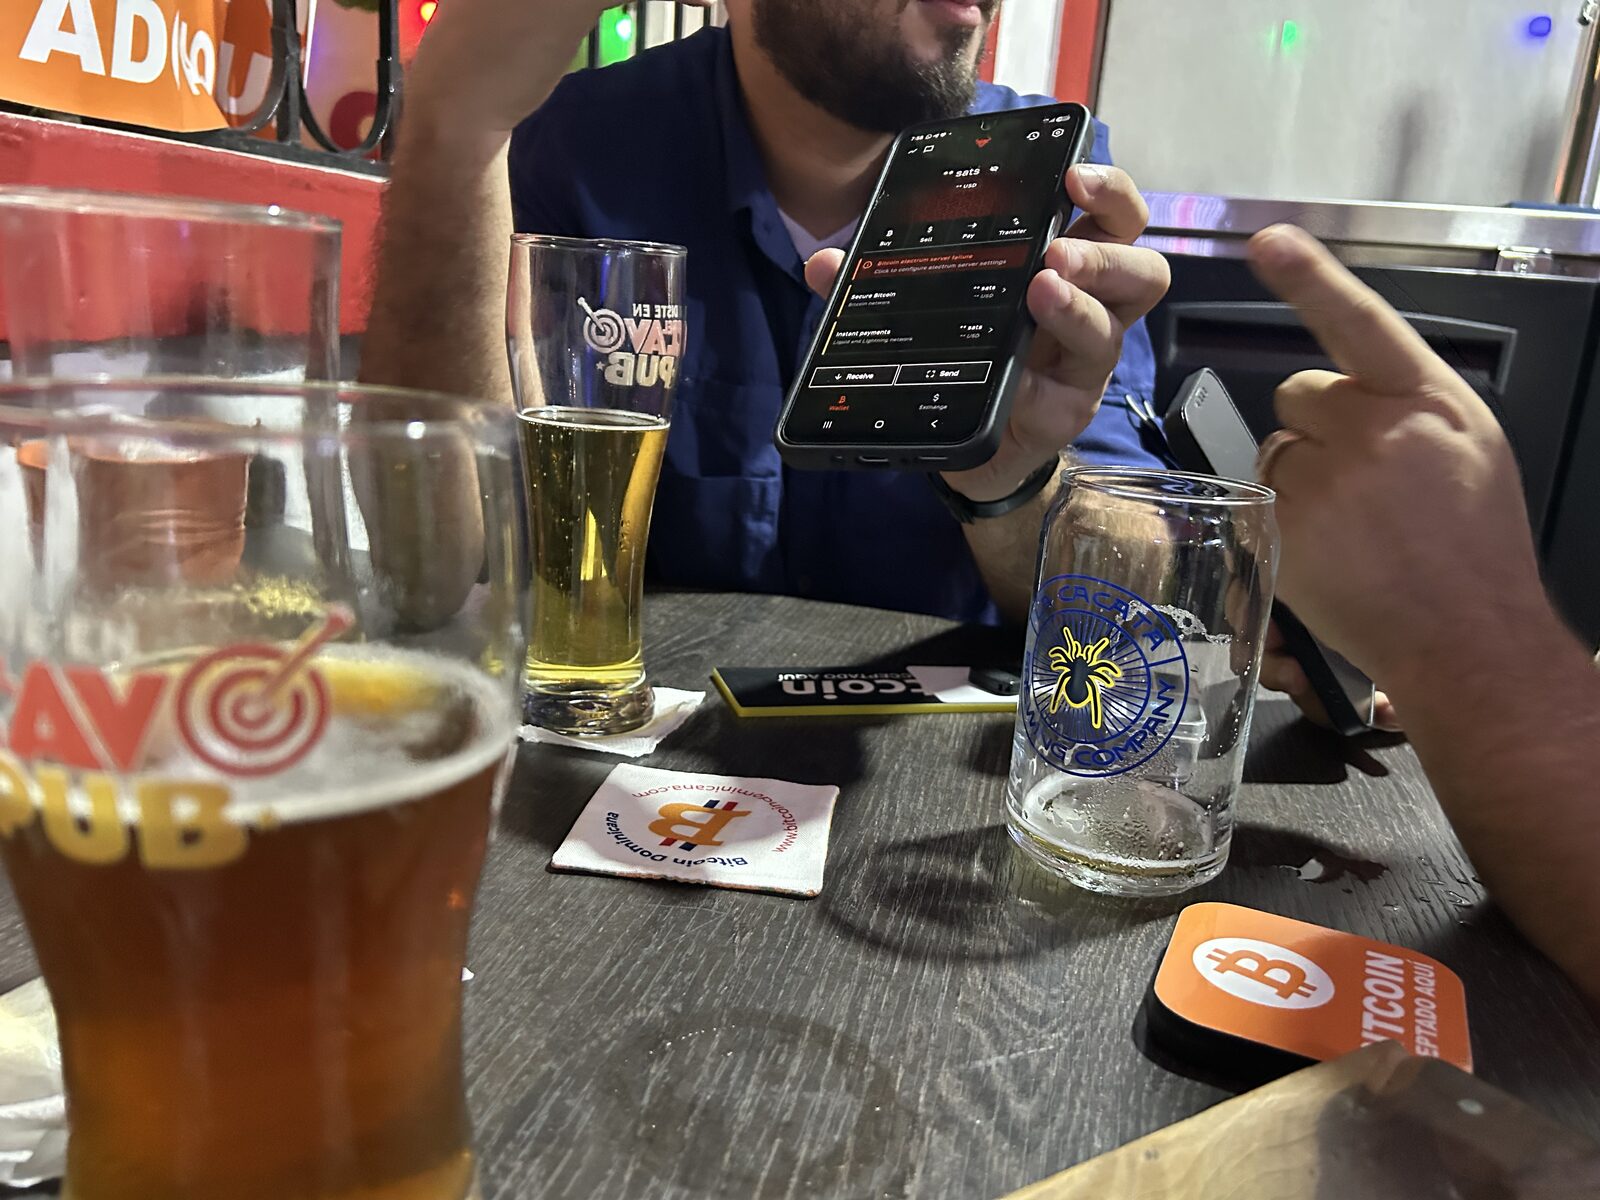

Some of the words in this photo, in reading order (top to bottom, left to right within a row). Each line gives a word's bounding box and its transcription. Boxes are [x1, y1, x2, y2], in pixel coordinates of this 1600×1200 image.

[955, 167, 981, 178] sats
[962, 232, 975, 240] Pay
[998, 228, 1027, 236] Transfer
[877, 259, 900, 267] Bitcoin
[900, 256, 929, 264] electrum
[898, 264, 927, 274] configure
[979, 259, 1007, 267] settings
[874, 291, 896, 299] Bitcoin
[859, 329, 891, 338] payments
[939, 369, 960, 377] Send
[1059, 584, 1166, 651] CACATA
[782, 679, 932, 700] tcoin
[1074, 679, 1176, 766] COMPANY
[606, 811, 668, 862] Dominicana
[673, 856, 749, 868] Bitcoin
[1406, 959, 1436, 998] AQUÍ
[1360, 950, 1404, 1047] ITCOIN
[1414, 997, 1439, 1058] EPTADO
